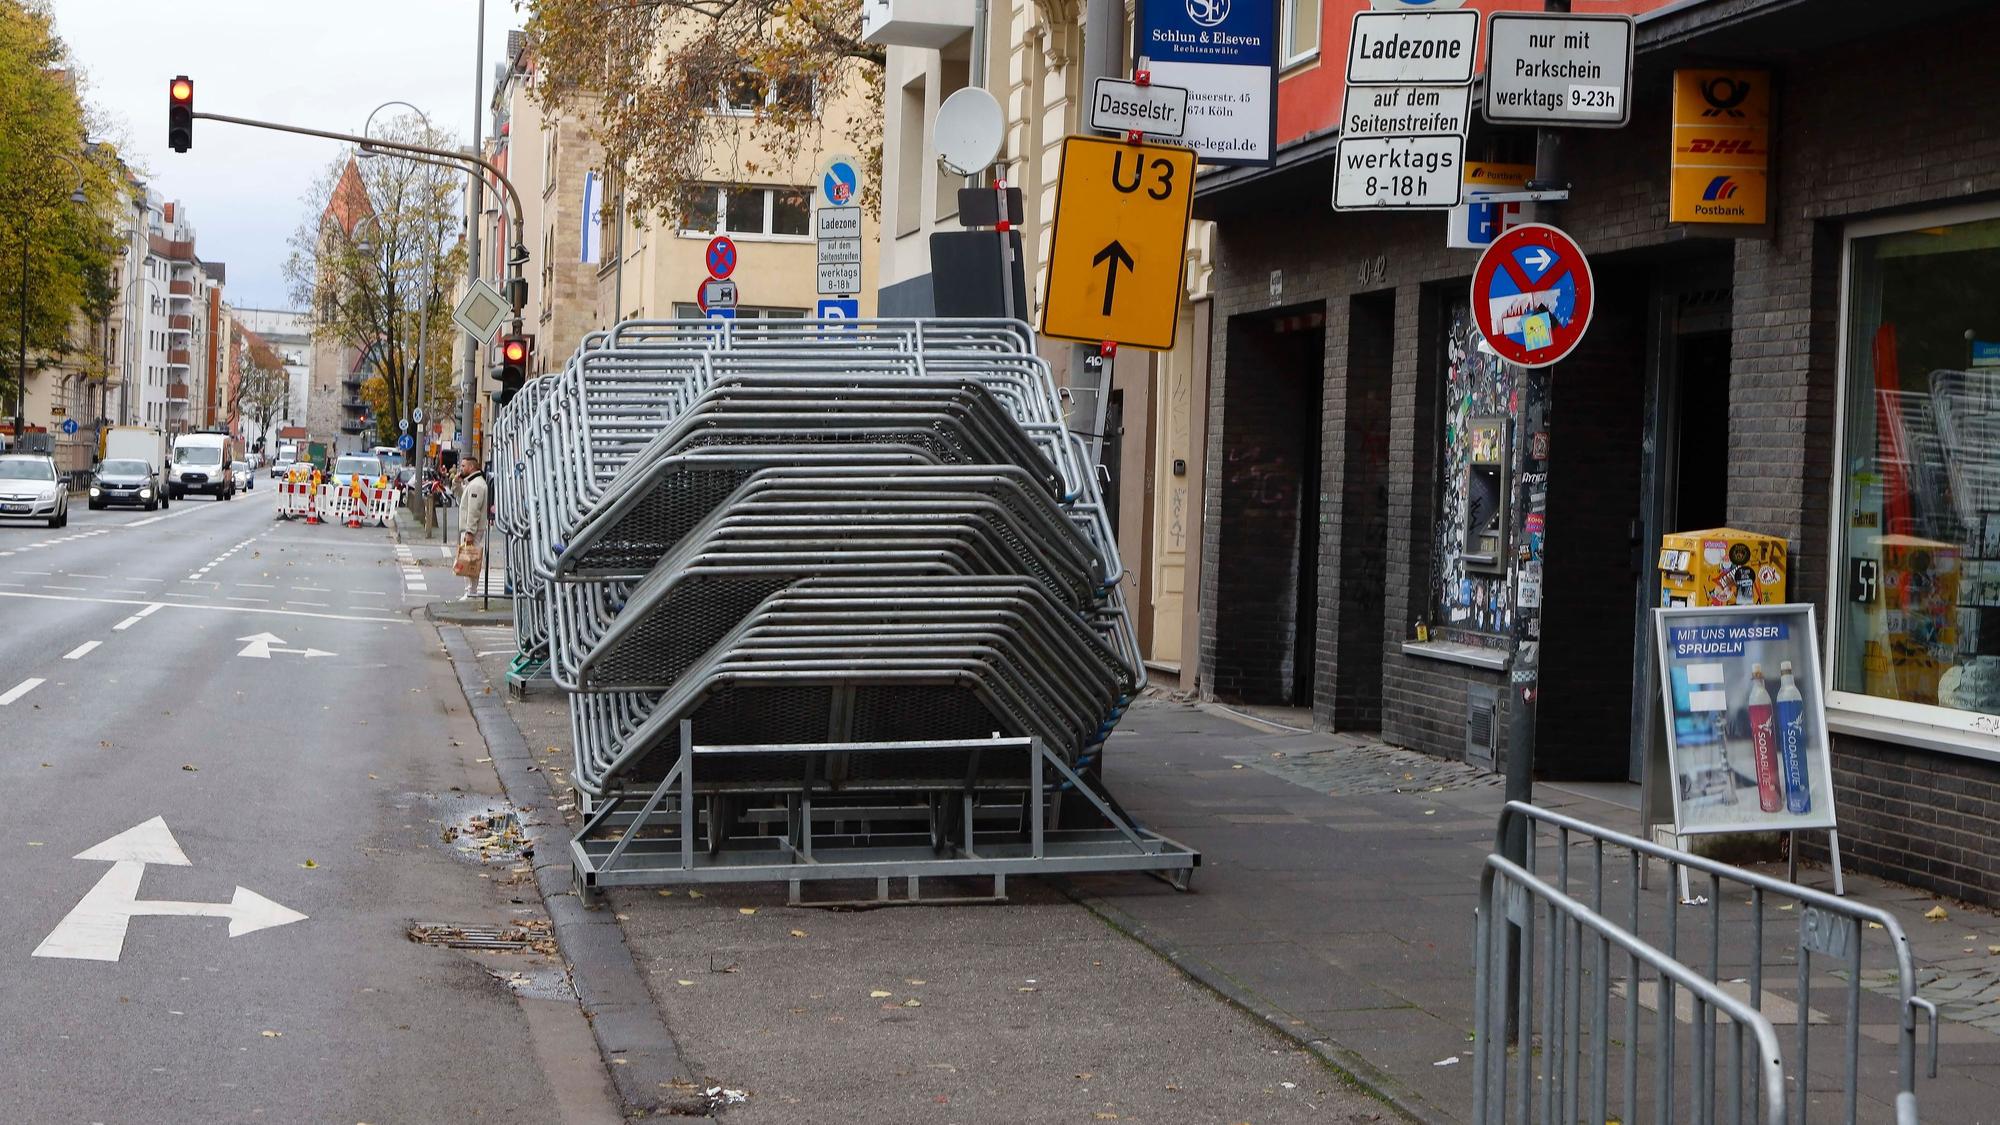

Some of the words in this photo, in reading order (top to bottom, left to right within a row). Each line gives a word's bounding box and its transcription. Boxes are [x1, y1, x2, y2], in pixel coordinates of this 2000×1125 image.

[1152, 28, 1196, 43] Schlun
[1199, 31, 1210, 44] &
[1212, 32, 1261, 46] Elseven
[1529, 34, 1555, 48] nur
[1563, 31, 1590, 49] mit
[1173, 44, 1239, 55] Rechtsanwälte
[1360, 33, 1461, 60] Ladezone
[1515, 59, 1601, 79] Parkschein
[1187, 90, 1236, 103] äuserstr.
[1238, 92, 1251, 103] 45
[1374, 88, 1399, 107] auf
[1406, 88, 1440, 106] dem
[1496, 88, 1564, 111] werktags
[1571, 90, 1616, 108] 9-23h
[1100, 94, 1177, 122] Dasselstr.
[1208, 103, 1234, 117] Köln
[1350, 112, 1459, 133] Seitenstreifen
[1688, 138, 1755, 155] DHL
[1347, 148, 1453, 173] werktags
[1112, 150, 1175, 201] U3
[1487, 171, 1524, 181] Postbank
[1695, 204, 1745, 217] Postbank
[821, 217, 857, 230] Ladezone
[827, 240, 837, 250] auf
[839, 240, 851, 250] dem
[820, 252, 859, 262] Seitenstreifen
[820, 268, 858, 280] werktags
[1085, 356, 1103, 367] 40
[1677, 630, 1698, 640] MIT
[1701, 628, 1725, 640] UNS
[1729, 627, 1779, 639] WASSER
[1678, 643, 1742, 655] SPRUDELN
